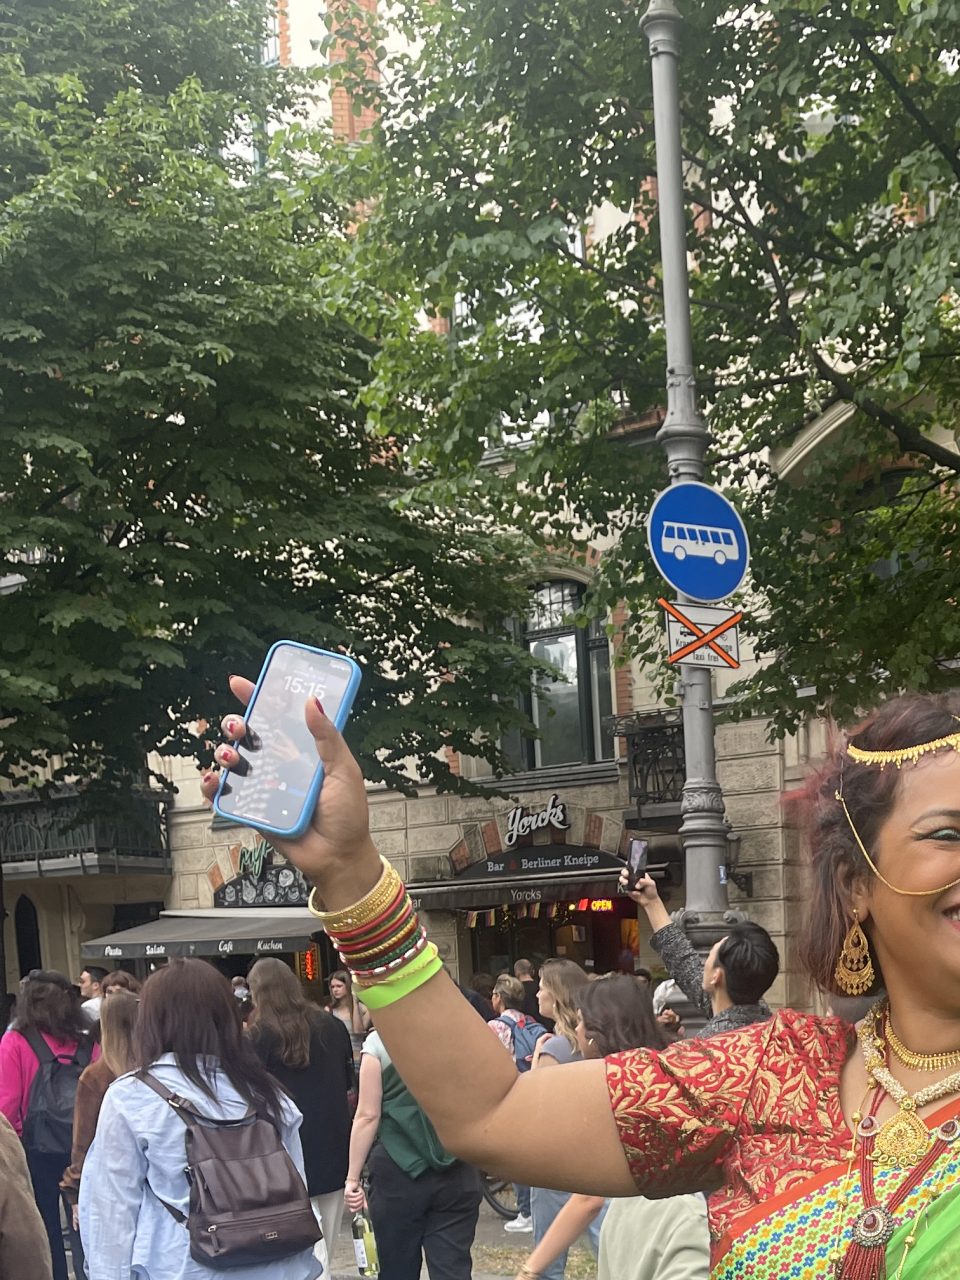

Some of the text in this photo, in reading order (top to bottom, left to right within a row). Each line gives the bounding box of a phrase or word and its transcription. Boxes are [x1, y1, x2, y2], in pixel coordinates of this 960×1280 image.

[284, 675, 327, 699] 15:15
[504, 795, 569, 846] Yorcks
[487, 861, 504, 872] Bar
[521, 857, 561, 869] Berliner
[564, 854, 599, 866] Kneipe
[510, 889, 542, 901] Yorcks
[591, 899, 613, 911] OPEN
[257, 940, 283, 951] Kuchen
